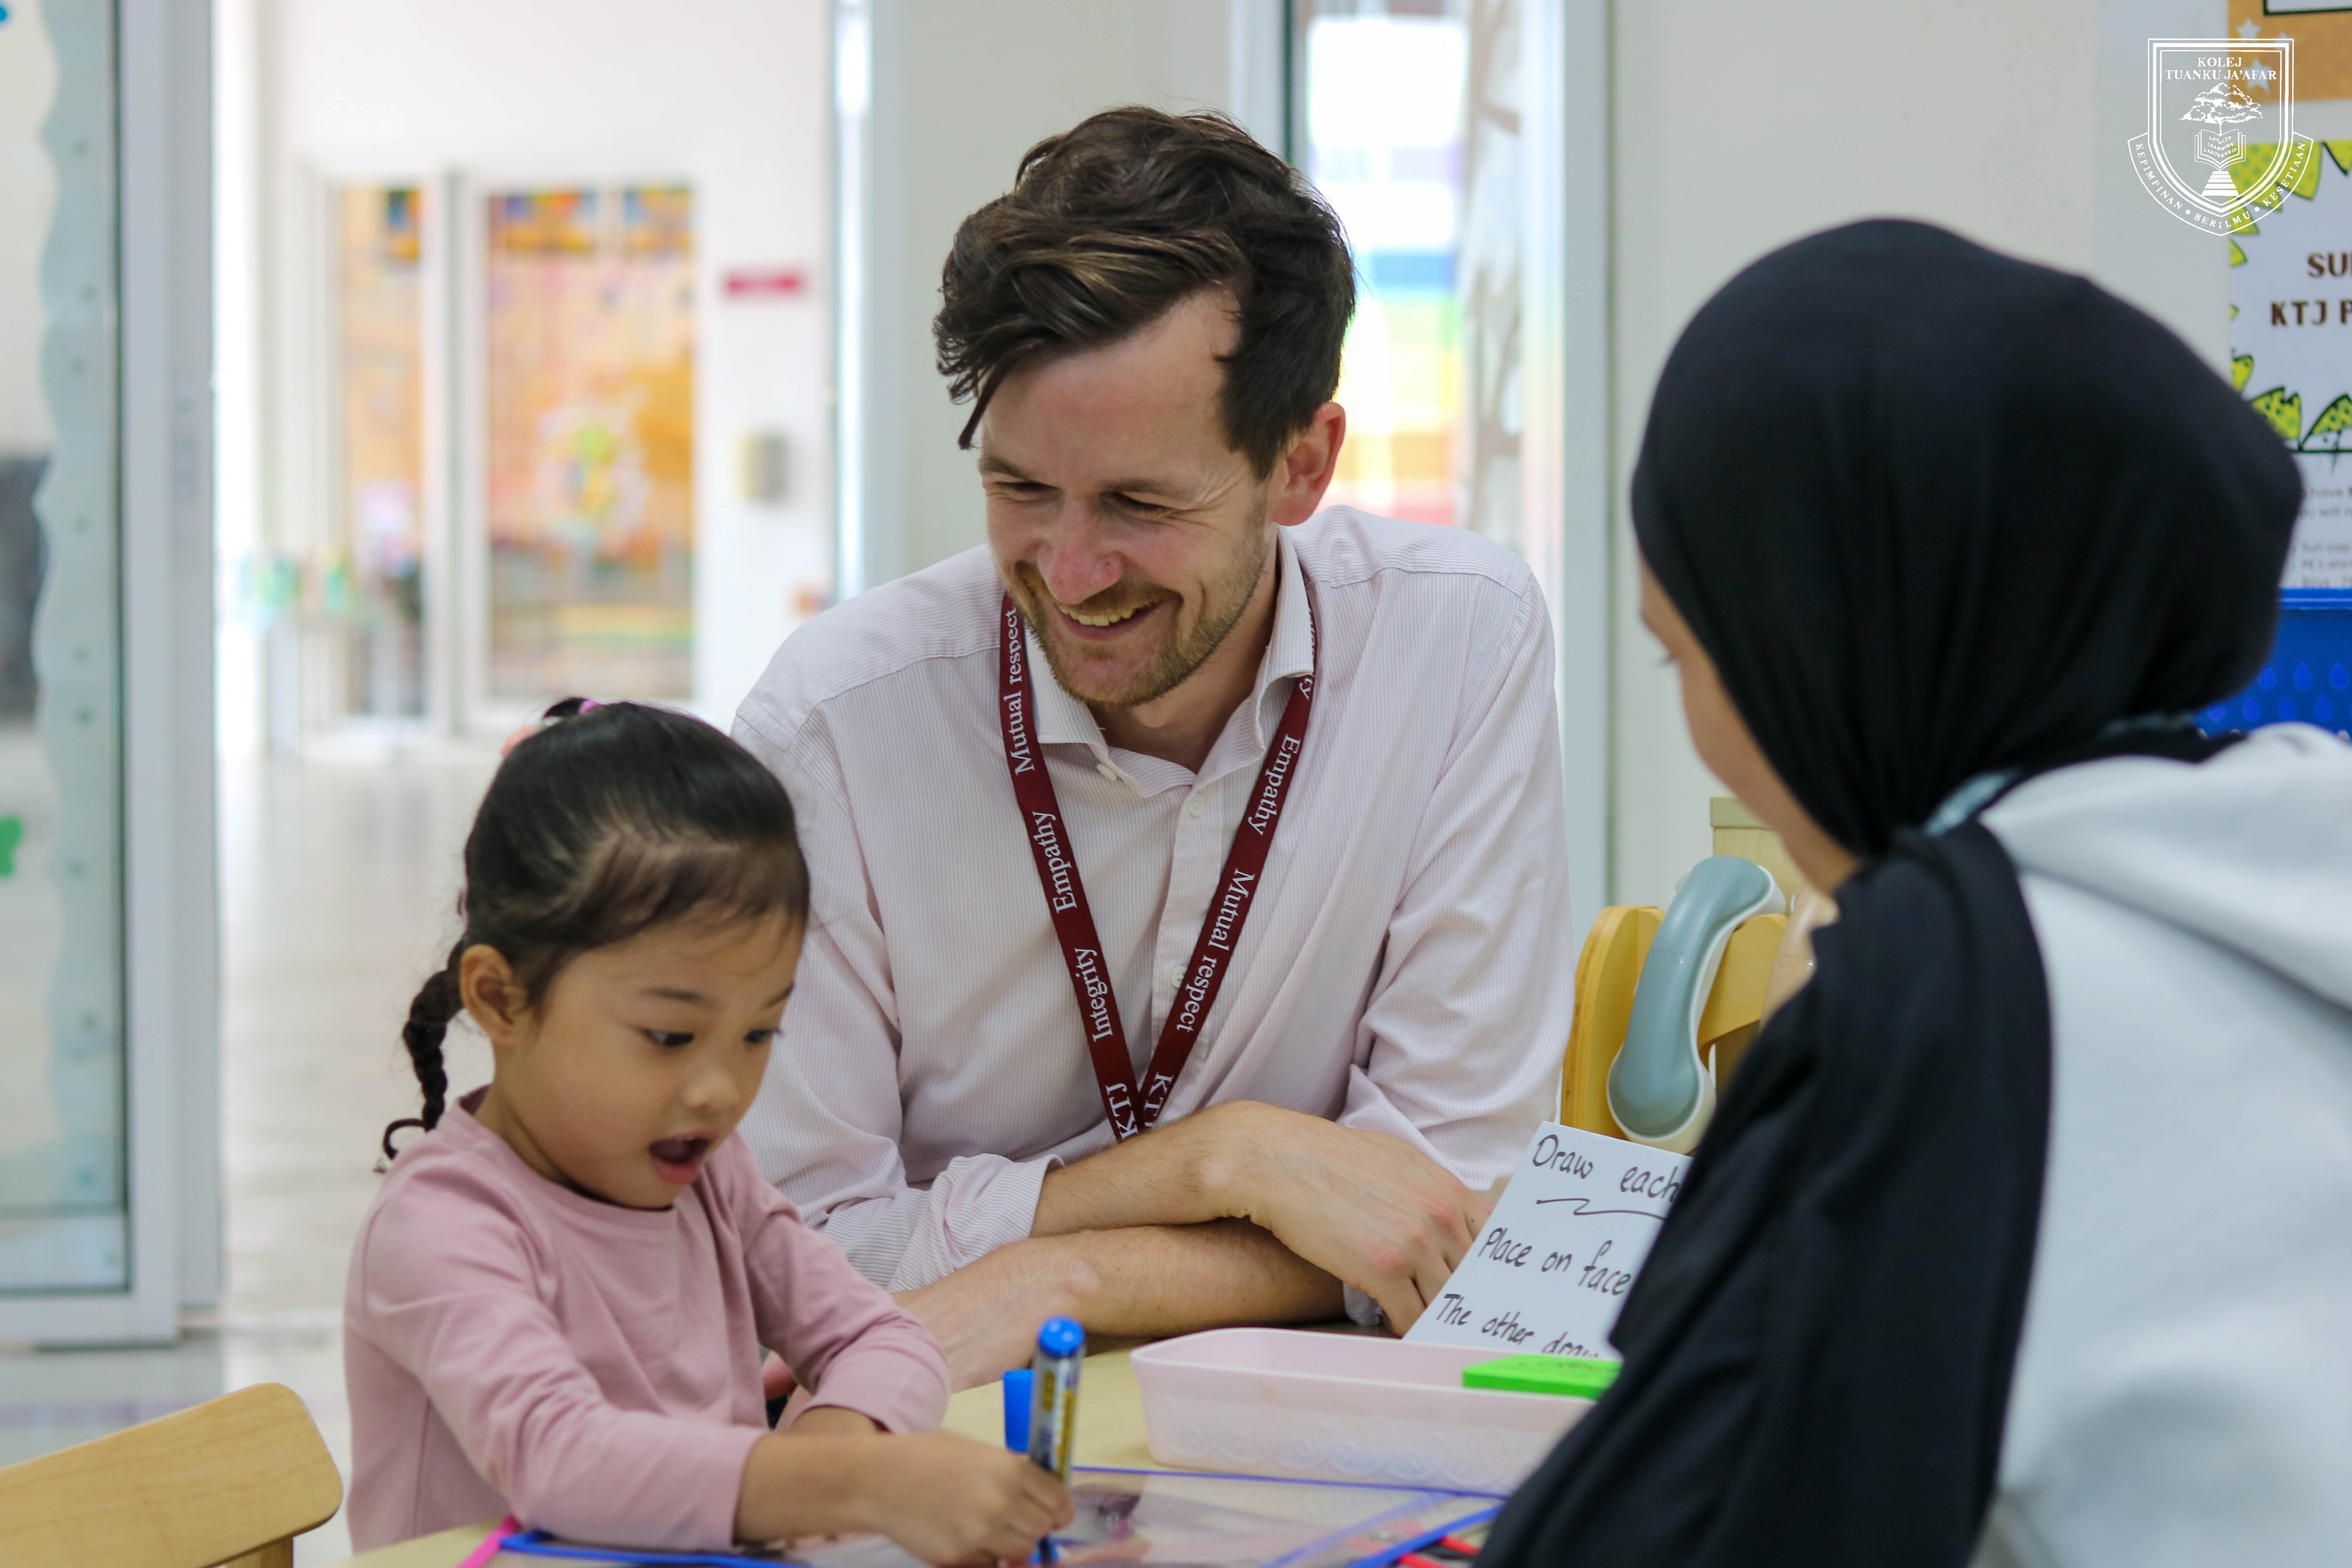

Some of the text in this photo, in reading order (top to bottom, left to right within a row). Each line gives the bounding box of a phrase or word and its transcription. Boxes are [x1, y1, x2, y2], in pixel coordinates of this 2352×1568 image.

[2308, 252, 2352, 278] SU
[2271, 300, 2327, 326] KTJ
[1003, 606, 1035, 776] Mutual respect
[1247, 733, 1301, 836] Empathy
[1032, 811, 1078, 914] Empathy
[1176, 867, 1256, 1033] Mutual respect
[1074, 947, 1113, 1043] Integrity
[1105, 1083, 1139, 1141] KTJ
[1532, 1134, 1681, 1203] Draw each
[1477, 1227, 1631, 1296] Place on face
[1436, 1293, 1472, 1326] The
[1481, 1311, 1535, 1345] other
